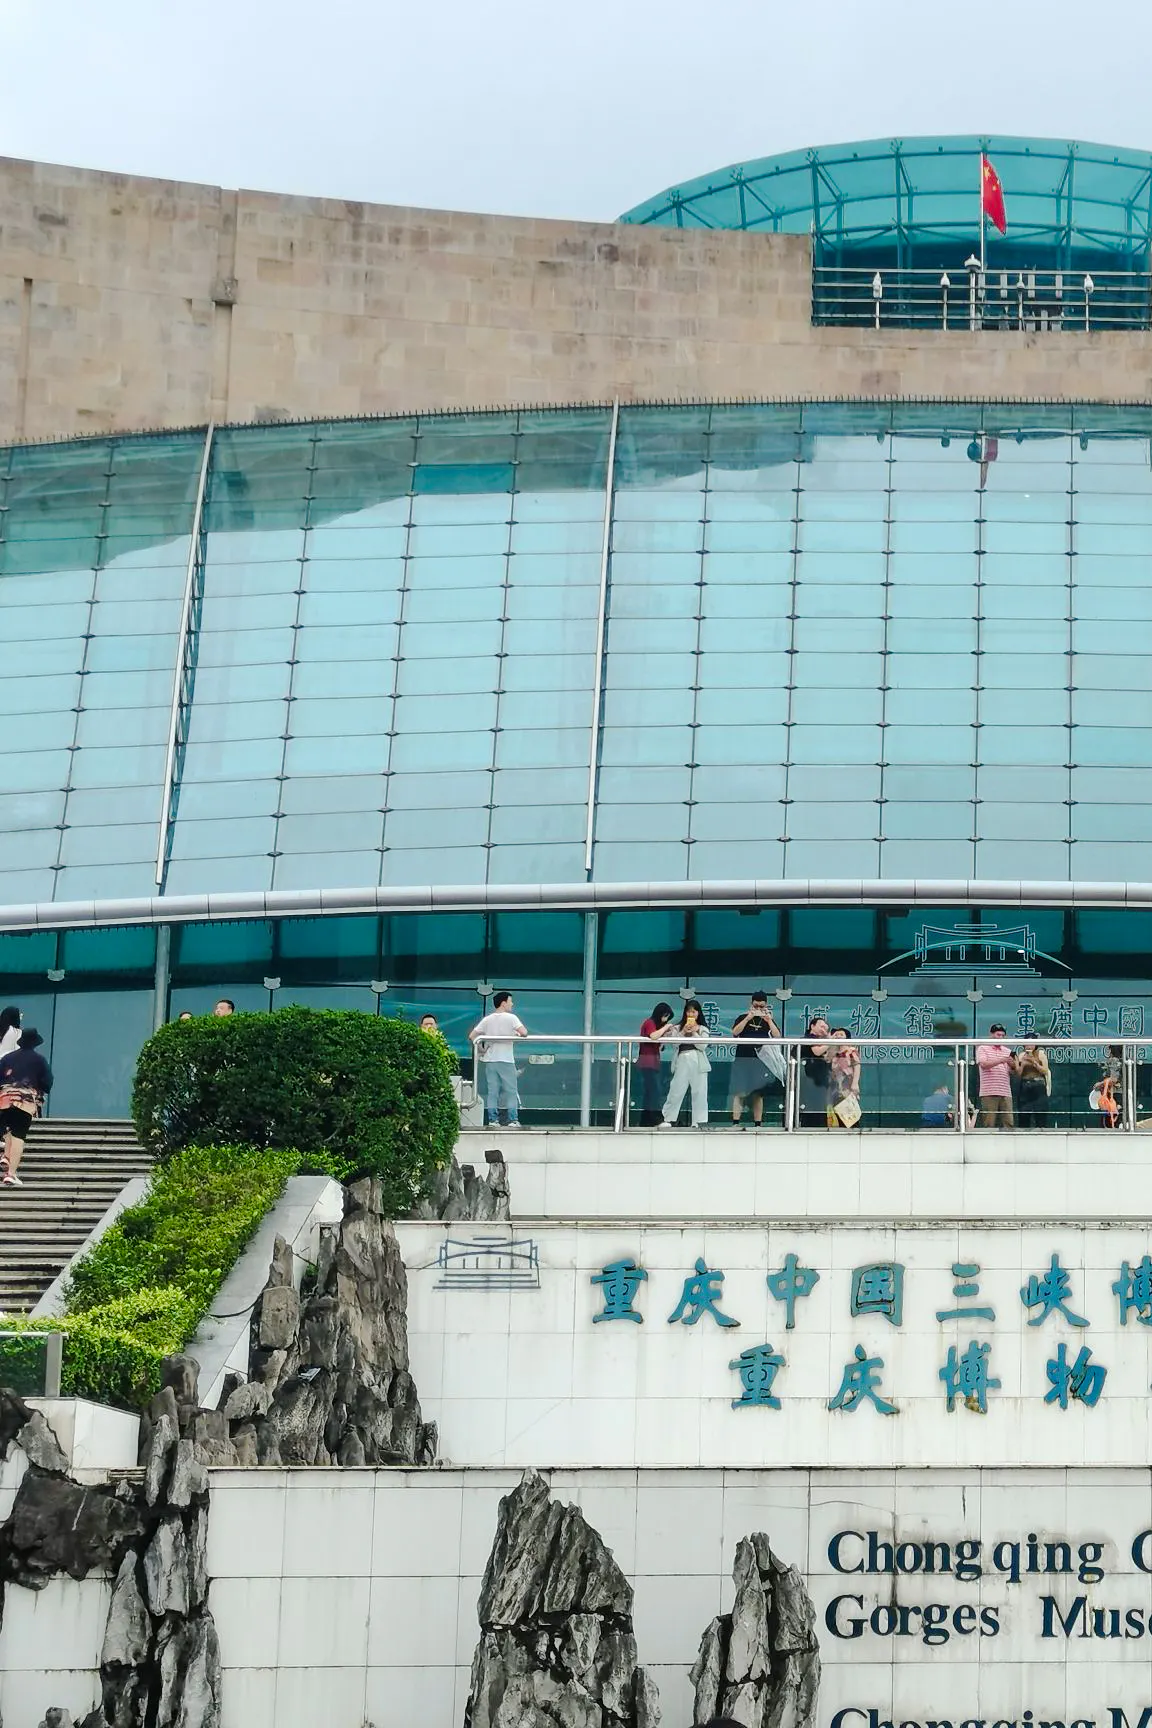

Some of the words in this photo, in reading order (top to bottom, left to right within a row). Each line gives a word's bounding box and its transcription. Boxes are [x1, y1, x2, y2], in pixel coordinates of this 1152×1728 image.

[860, 1045, 934, 1060] useum
[827, 1530, 1105, 1583] Chongqing
[824, 1593, 1000, 1645] Gorges
